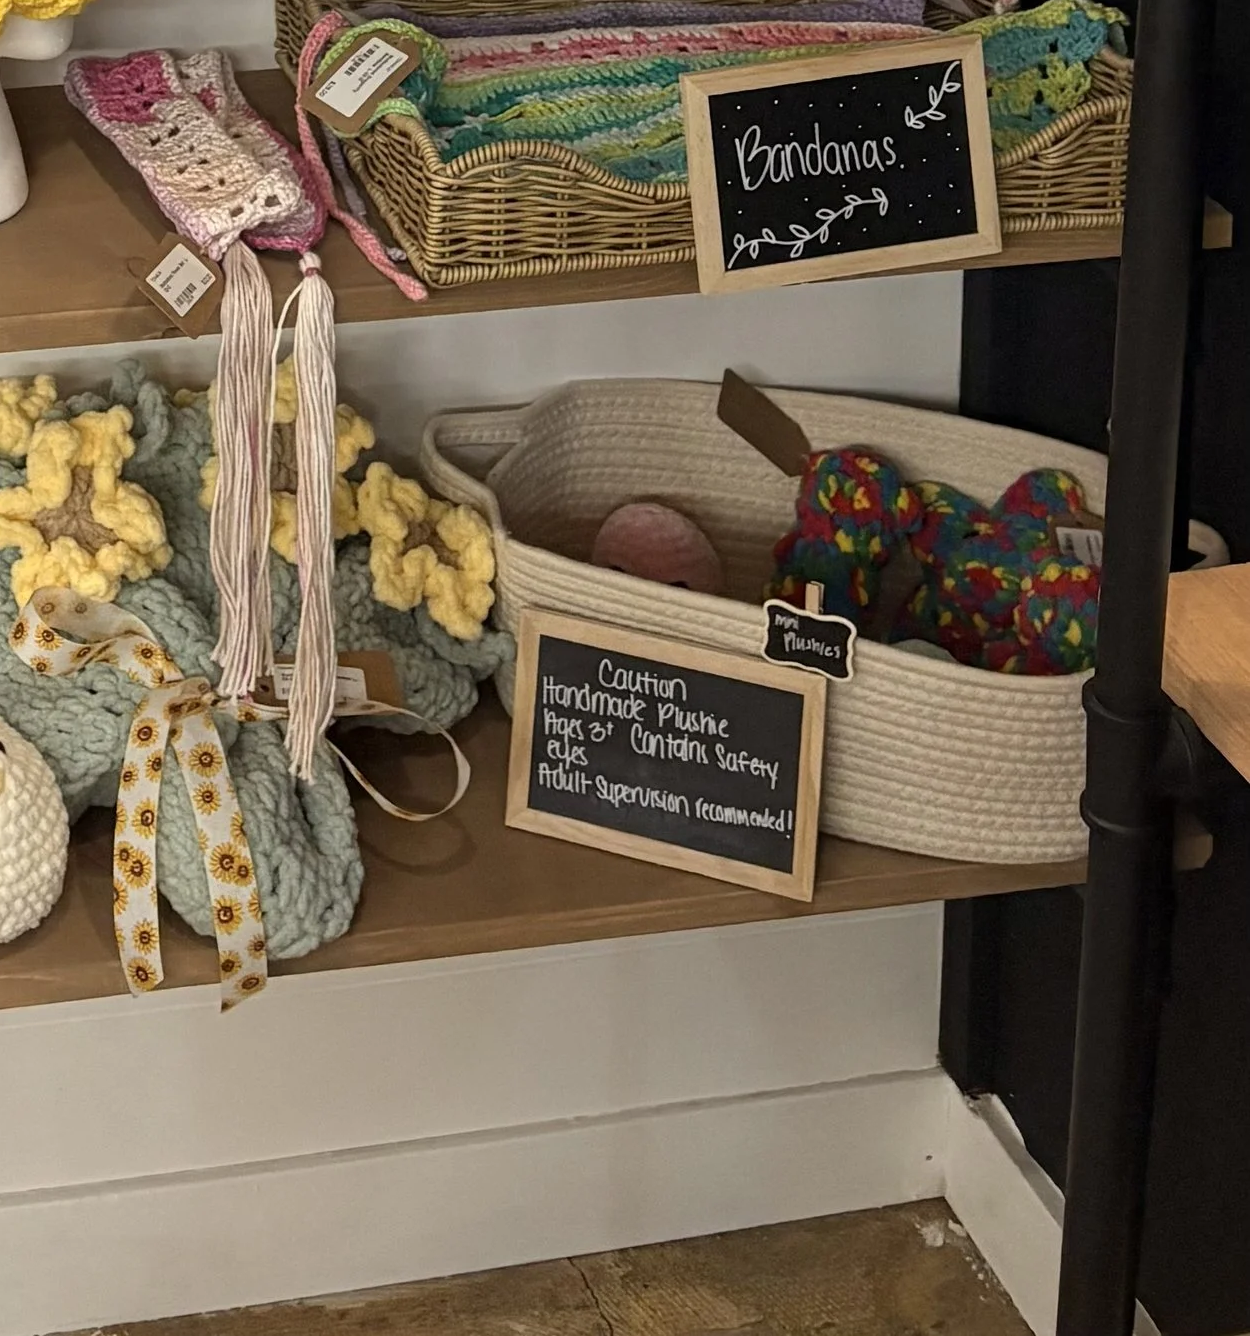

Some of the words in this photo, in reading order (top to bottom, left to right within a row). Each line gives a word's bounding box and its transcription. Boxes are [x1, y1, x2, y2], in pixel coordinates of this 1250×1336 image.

[735, 123, 896, 191] Bandanas
[599, 659, 687, 701] Caution
[543, 676, 647, 721] Handmade
[657, 703, 729, 738] Plushie
[544, 709, 584, 742] Ages
[630, 723, 708, 765] Contains
[547, 739, 588, 769] eyes
[538, 762, 592, 794] Adult
